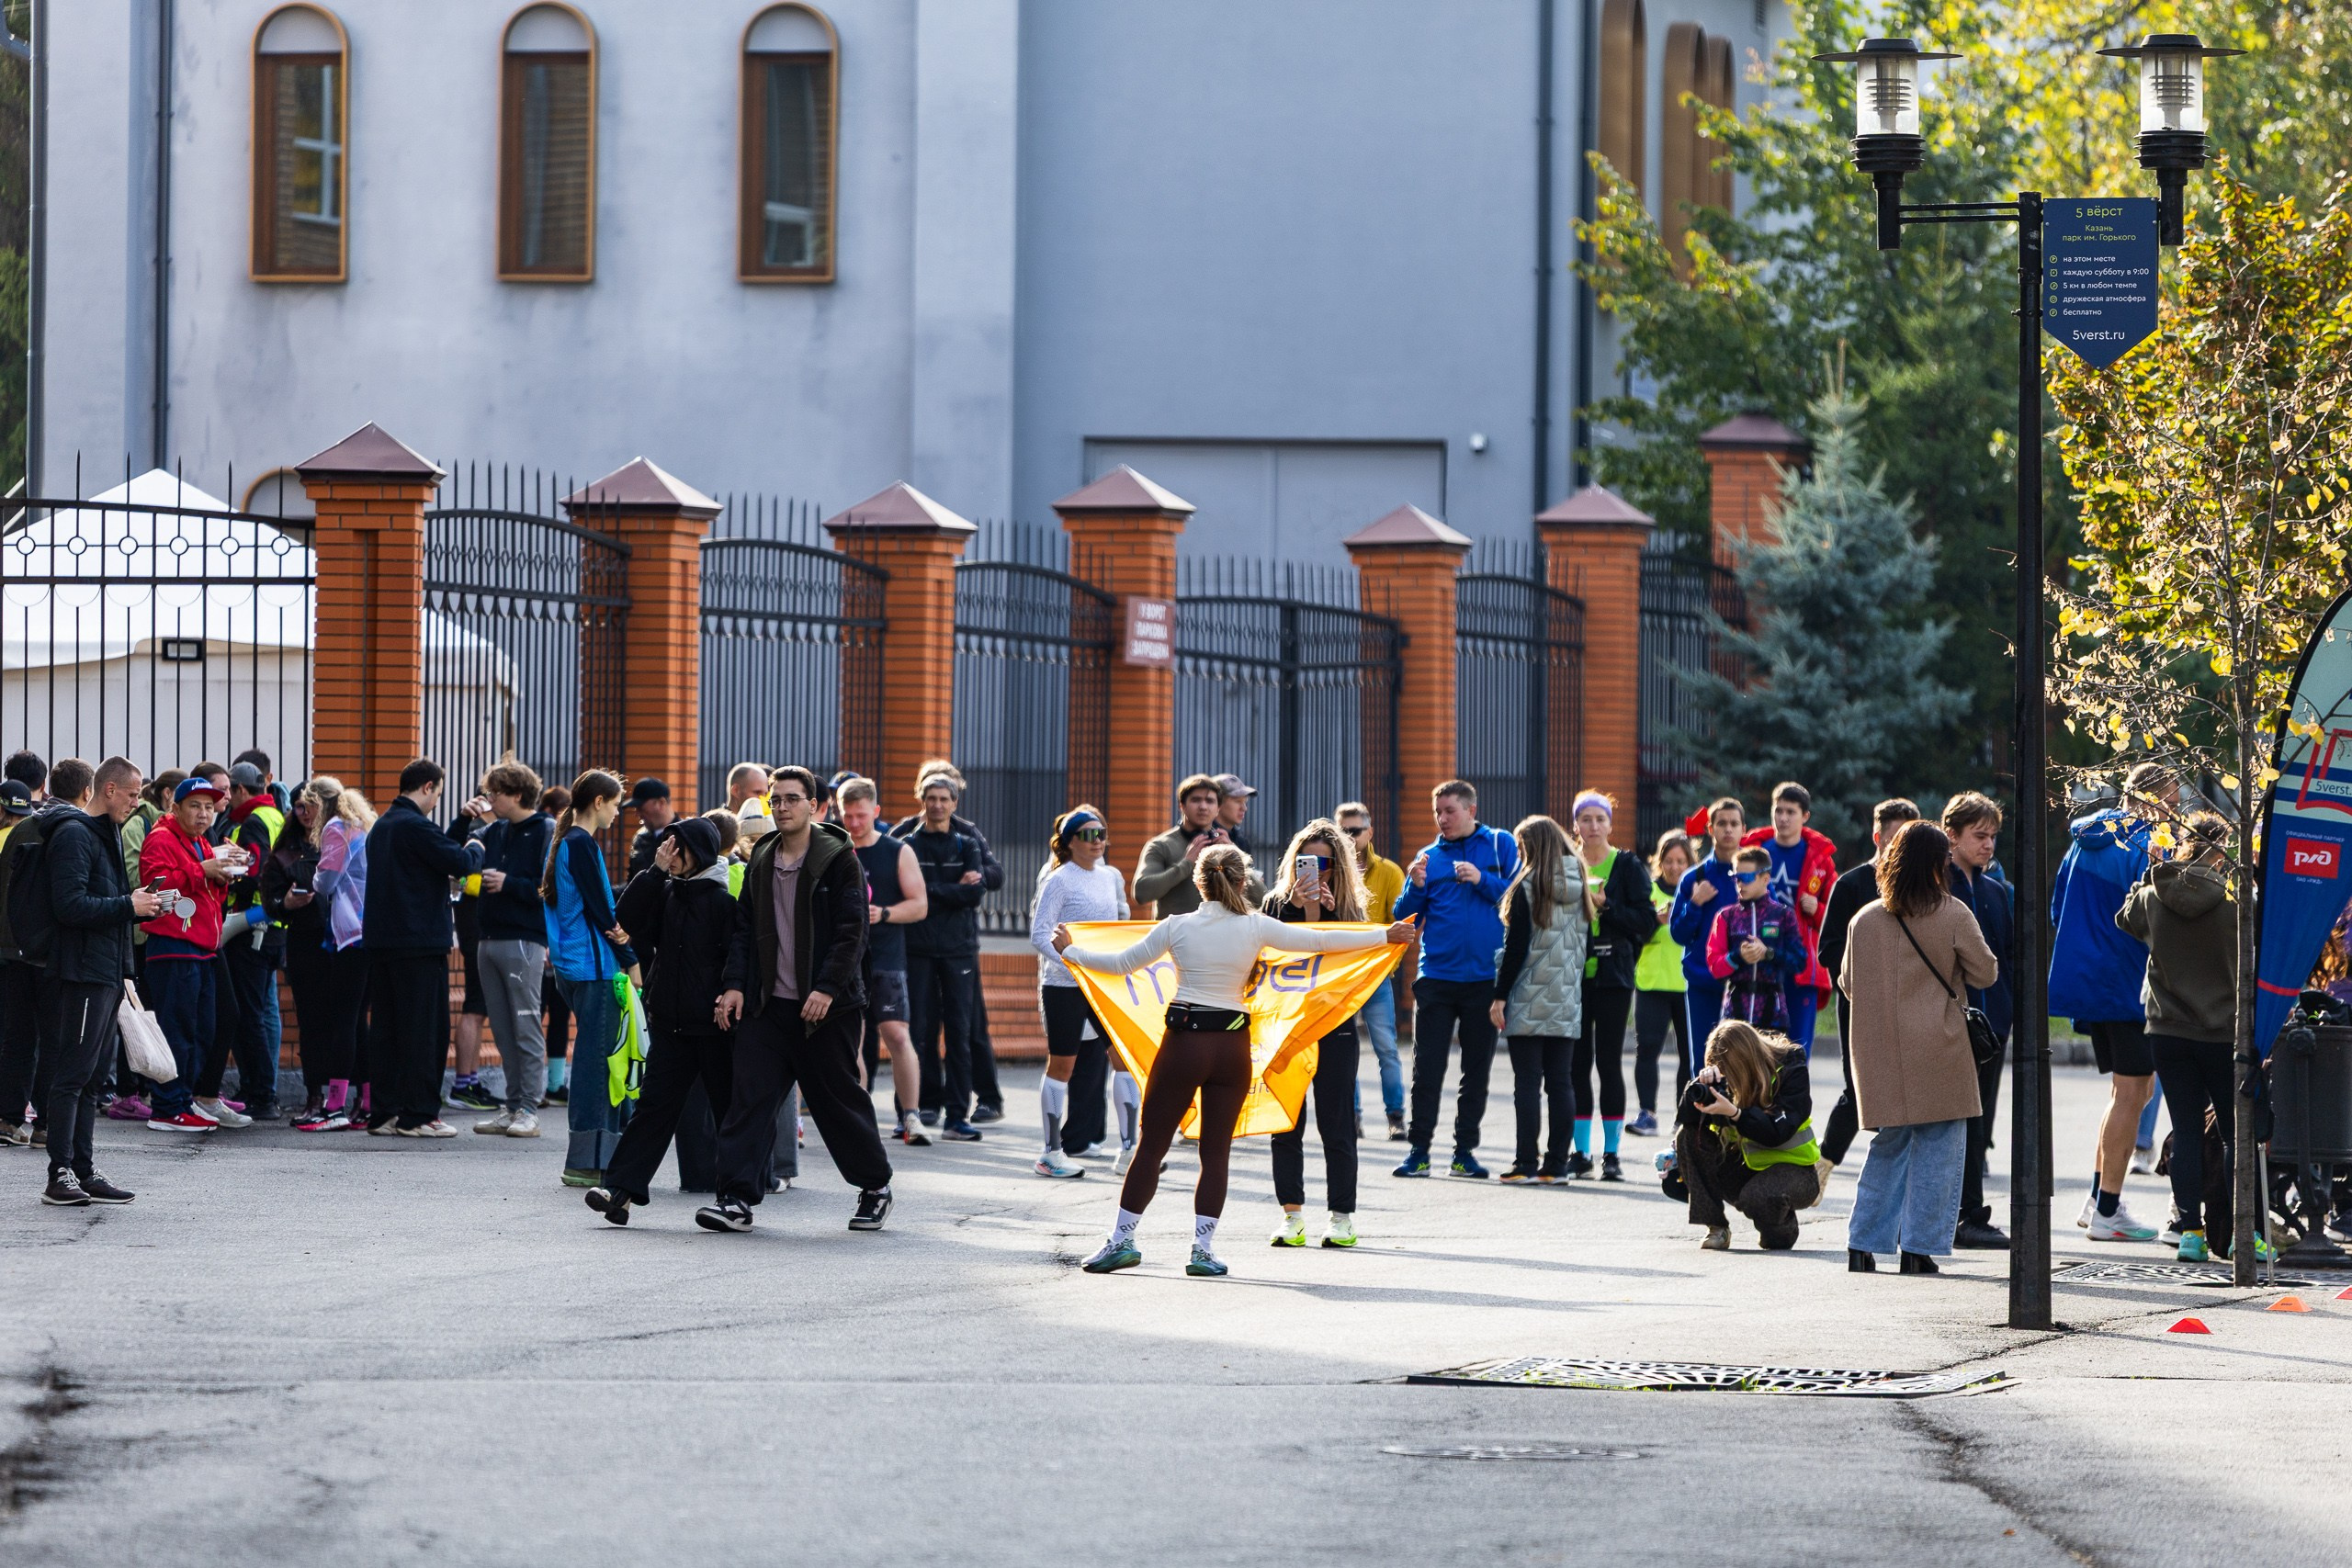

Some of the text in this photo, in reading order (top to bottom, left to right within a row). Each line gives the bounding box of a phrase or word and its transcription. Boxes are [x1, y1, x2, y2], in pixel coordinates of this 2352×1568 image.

[2075, 206, 2123, 218] 5 вёрст
[2063, 268, 2093, 276] каждую
[2094, 268, 2125, 276] субботу
[2105, 295, 2146, 303] атмосфера
[2073, 330, 2125, 340] 5verst.ru
